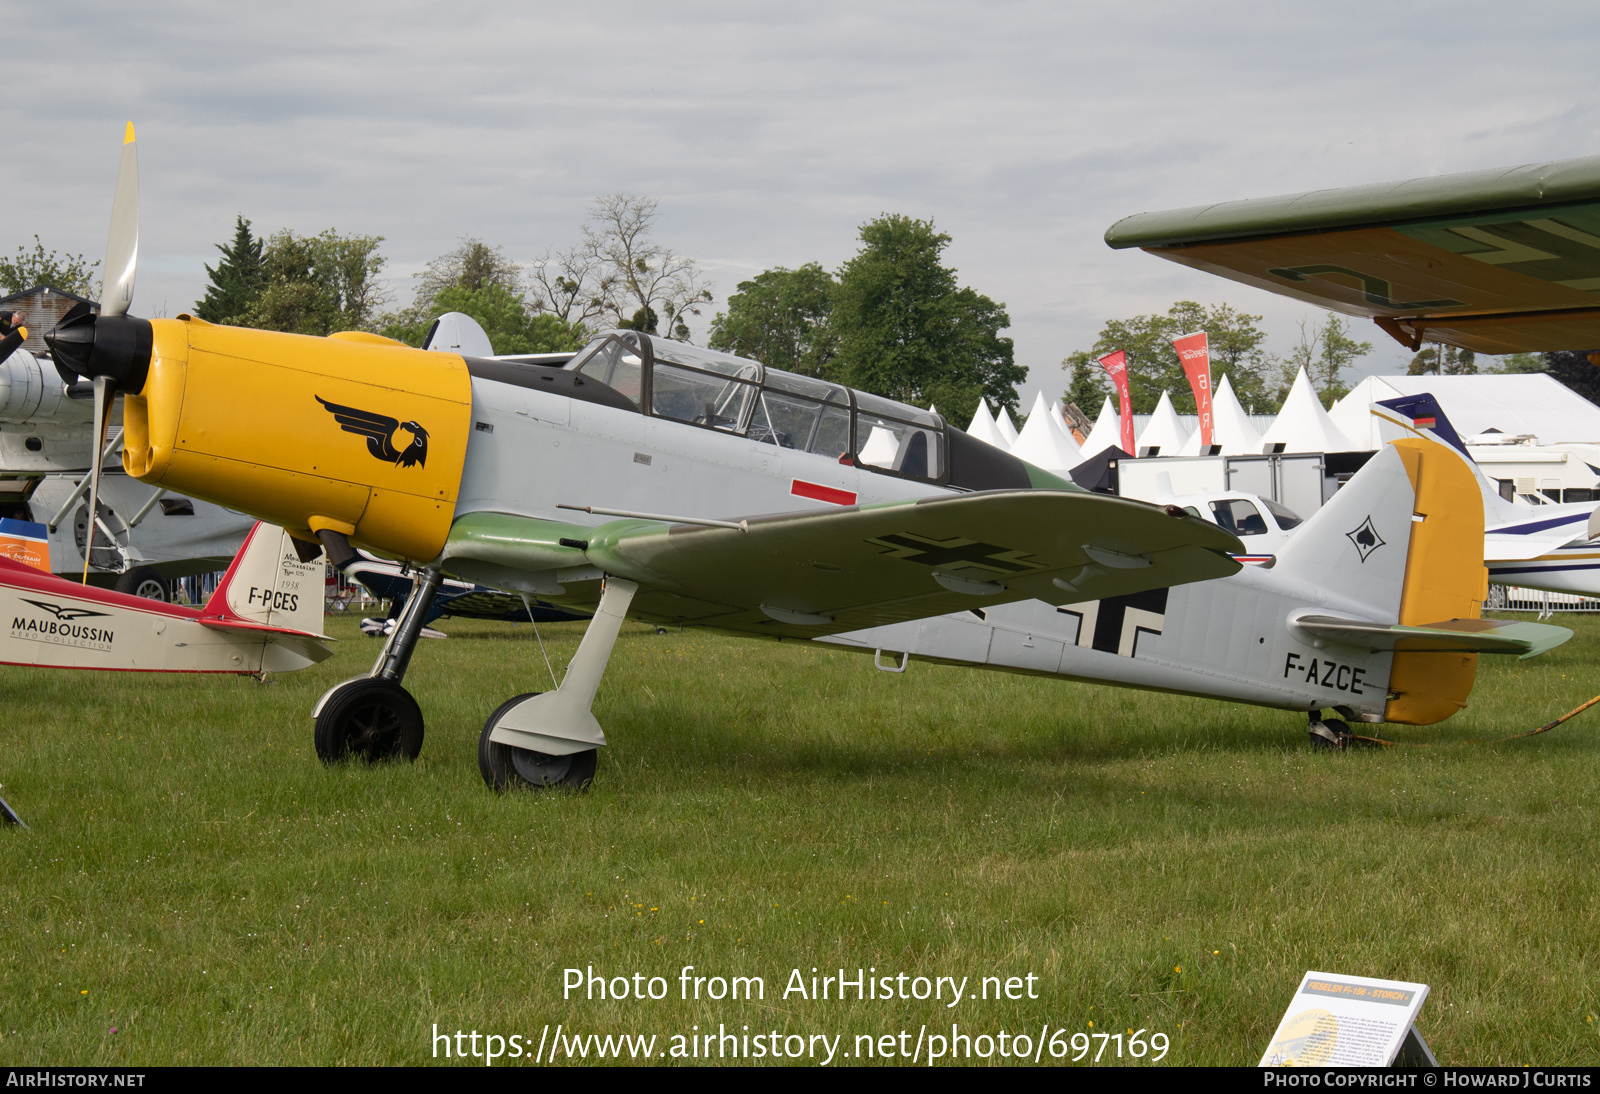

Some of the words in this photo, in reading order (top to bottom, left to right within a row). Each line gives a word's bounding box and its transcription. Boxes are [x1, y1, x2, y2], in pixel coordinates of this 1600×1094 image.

[281, 580, 300, 590] 1938
[248, 586, 299, 612] F-PCES
[11, 630, 38, 640] AERO
[45, 635, 112, 650] COLLECTION
[12, 617, 114, 643] MAUBOUSSIN
[1284, 652, 1367, 695] F-AZCE
[1372, 989, 1405, 1001] STORCH
